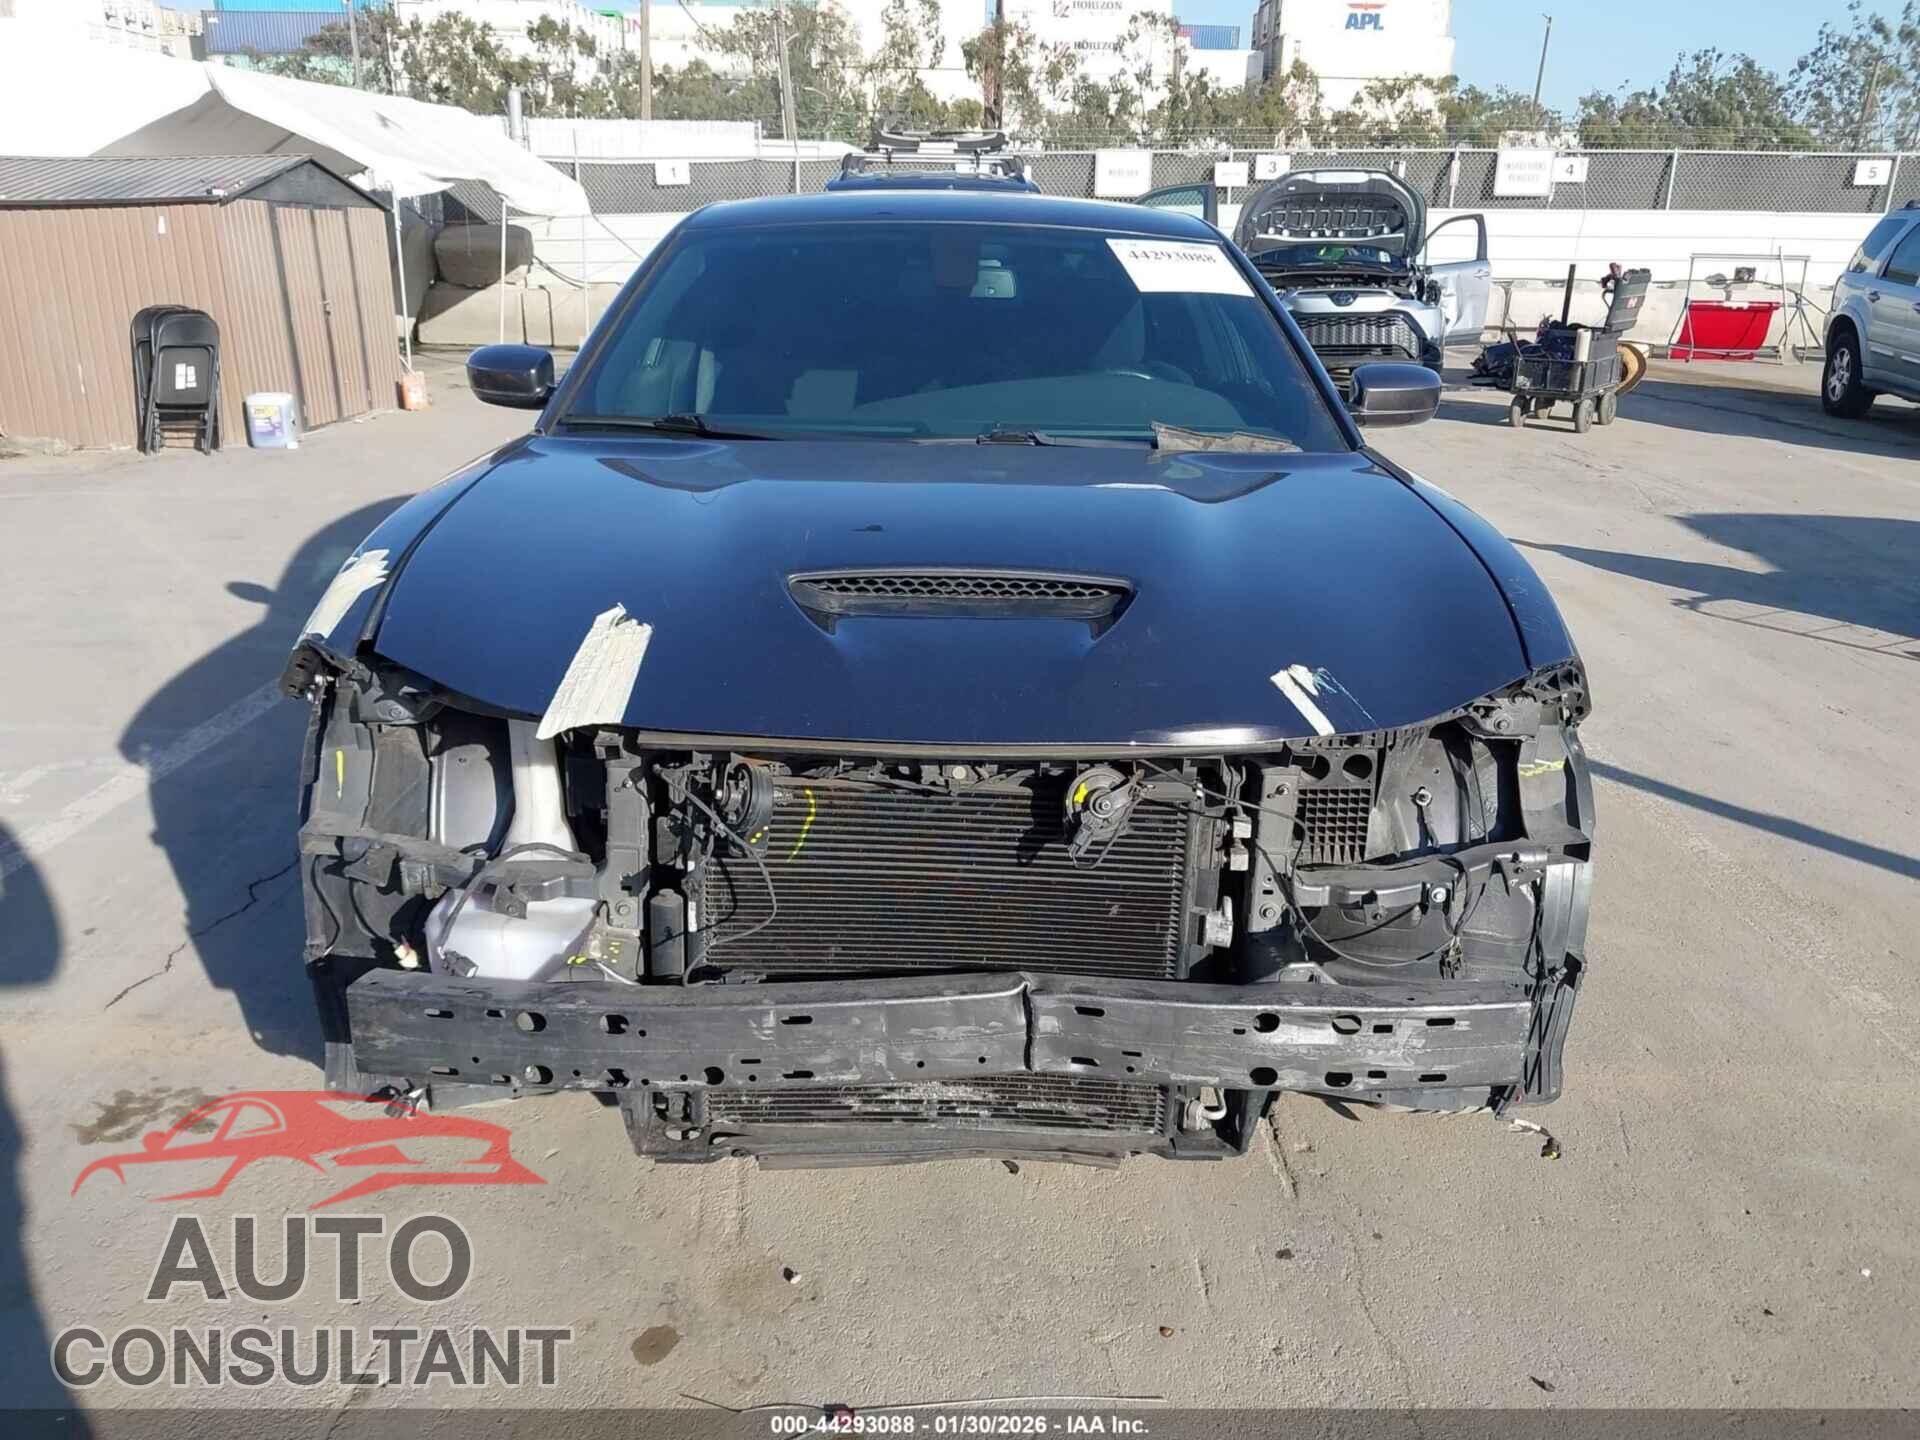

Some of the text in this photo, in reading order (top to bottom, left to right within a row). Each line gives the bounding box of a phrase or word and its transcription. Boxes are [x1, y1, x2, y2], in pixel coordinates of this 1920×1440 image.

[1072, 0, 1122, 9] HORIZON
[1345, 12, 1384, 30] APL
[1267, 161, 1277, 174] 3
[1565, 164, 1574, 176] 4
[1868, 166, 1878, 180] 5
